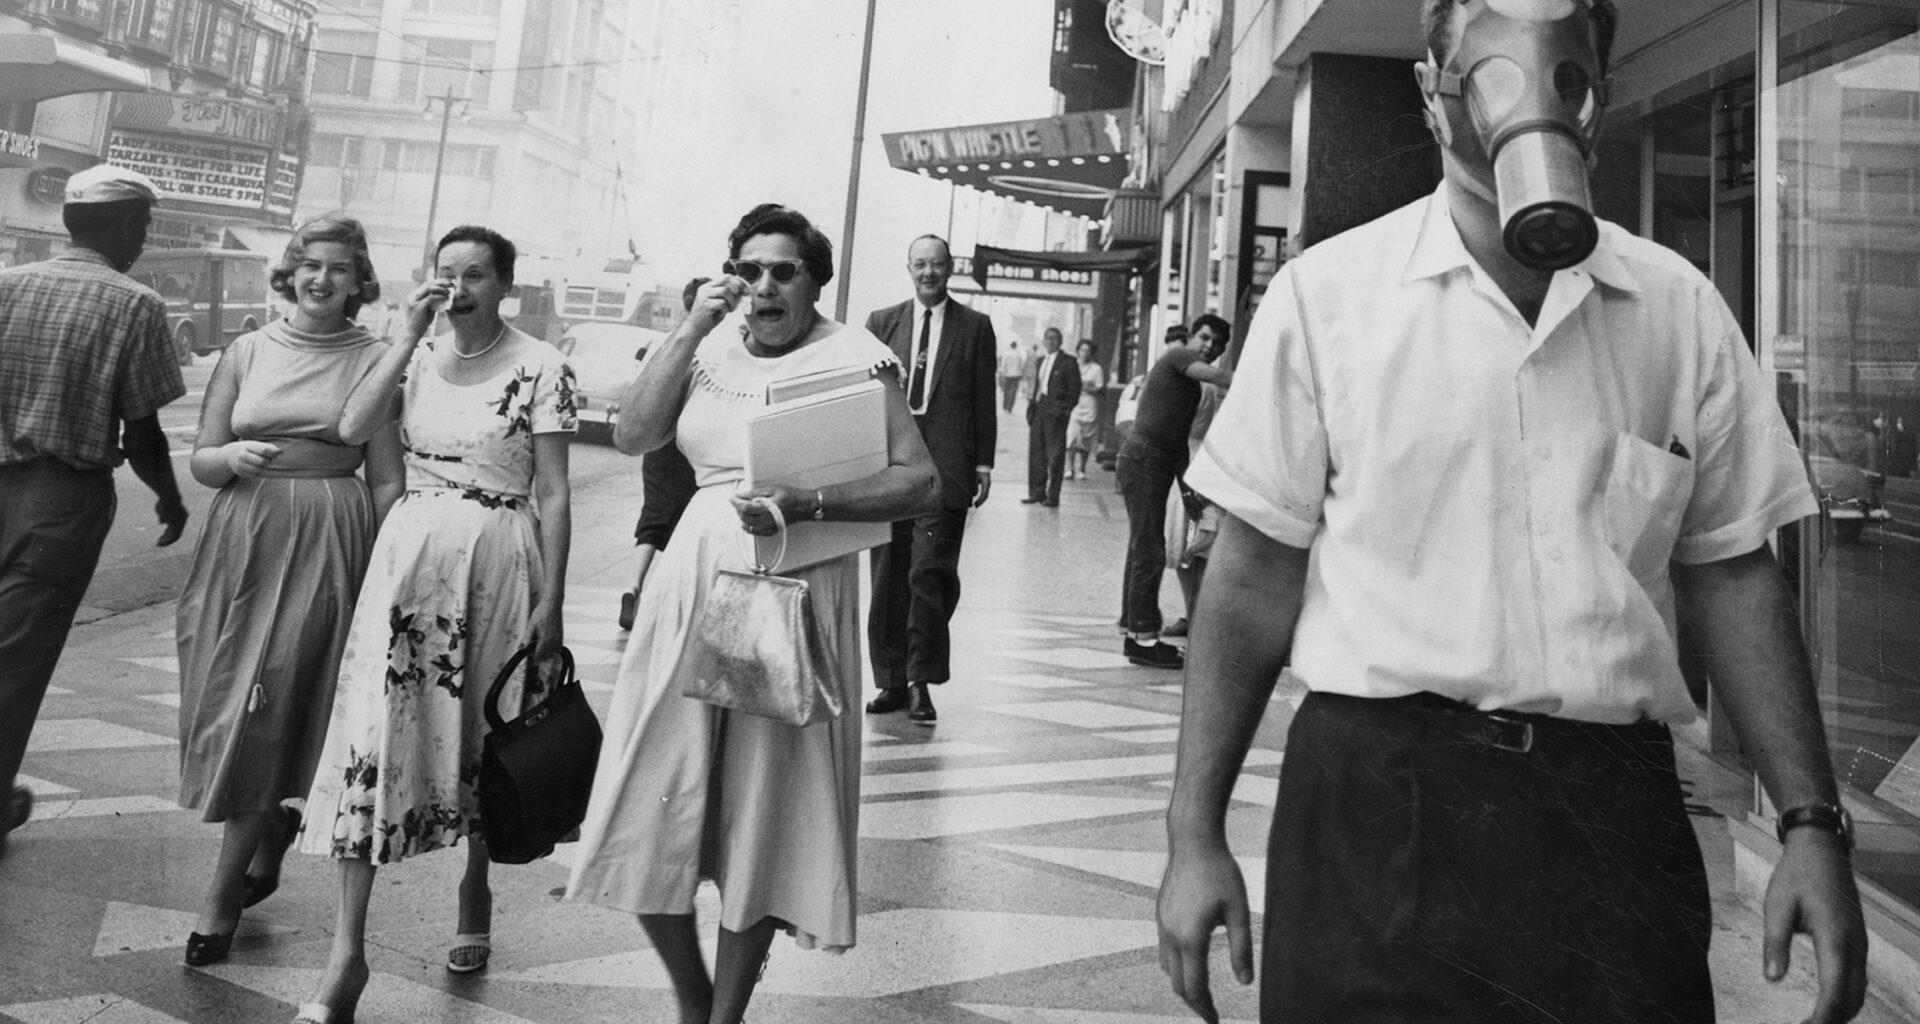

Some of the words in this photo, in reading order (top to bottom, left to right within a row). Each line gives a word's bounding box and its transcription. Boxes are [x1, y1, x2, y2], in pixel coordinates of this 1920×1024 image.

[9, 133, 40, 159] SHOES
[110, 136, 145, 149] ANDY
[149, 141, 193, 155] HARDY
[194, 147, 231, 160] COMES
[235, 153, 265, 164] HOME
[950, 123, 1041, 159] WHISTLE
[110, 149, 168, 165] TARZAN'S
[173, 156, 205, 170] FIGHT
[210, 161, 232, 173] FOR
[238, 165, 262, 177] LIFE
[132, 164, 163, 177] DAVIS
[175, 169, 205, 182] TONY
[205, 173, 265, 189] CASANOVA
[179, 183, 195, 194] ON
[198, 186, 233, 198] STAGE
[1040, 267, 1090, 283] shoes
